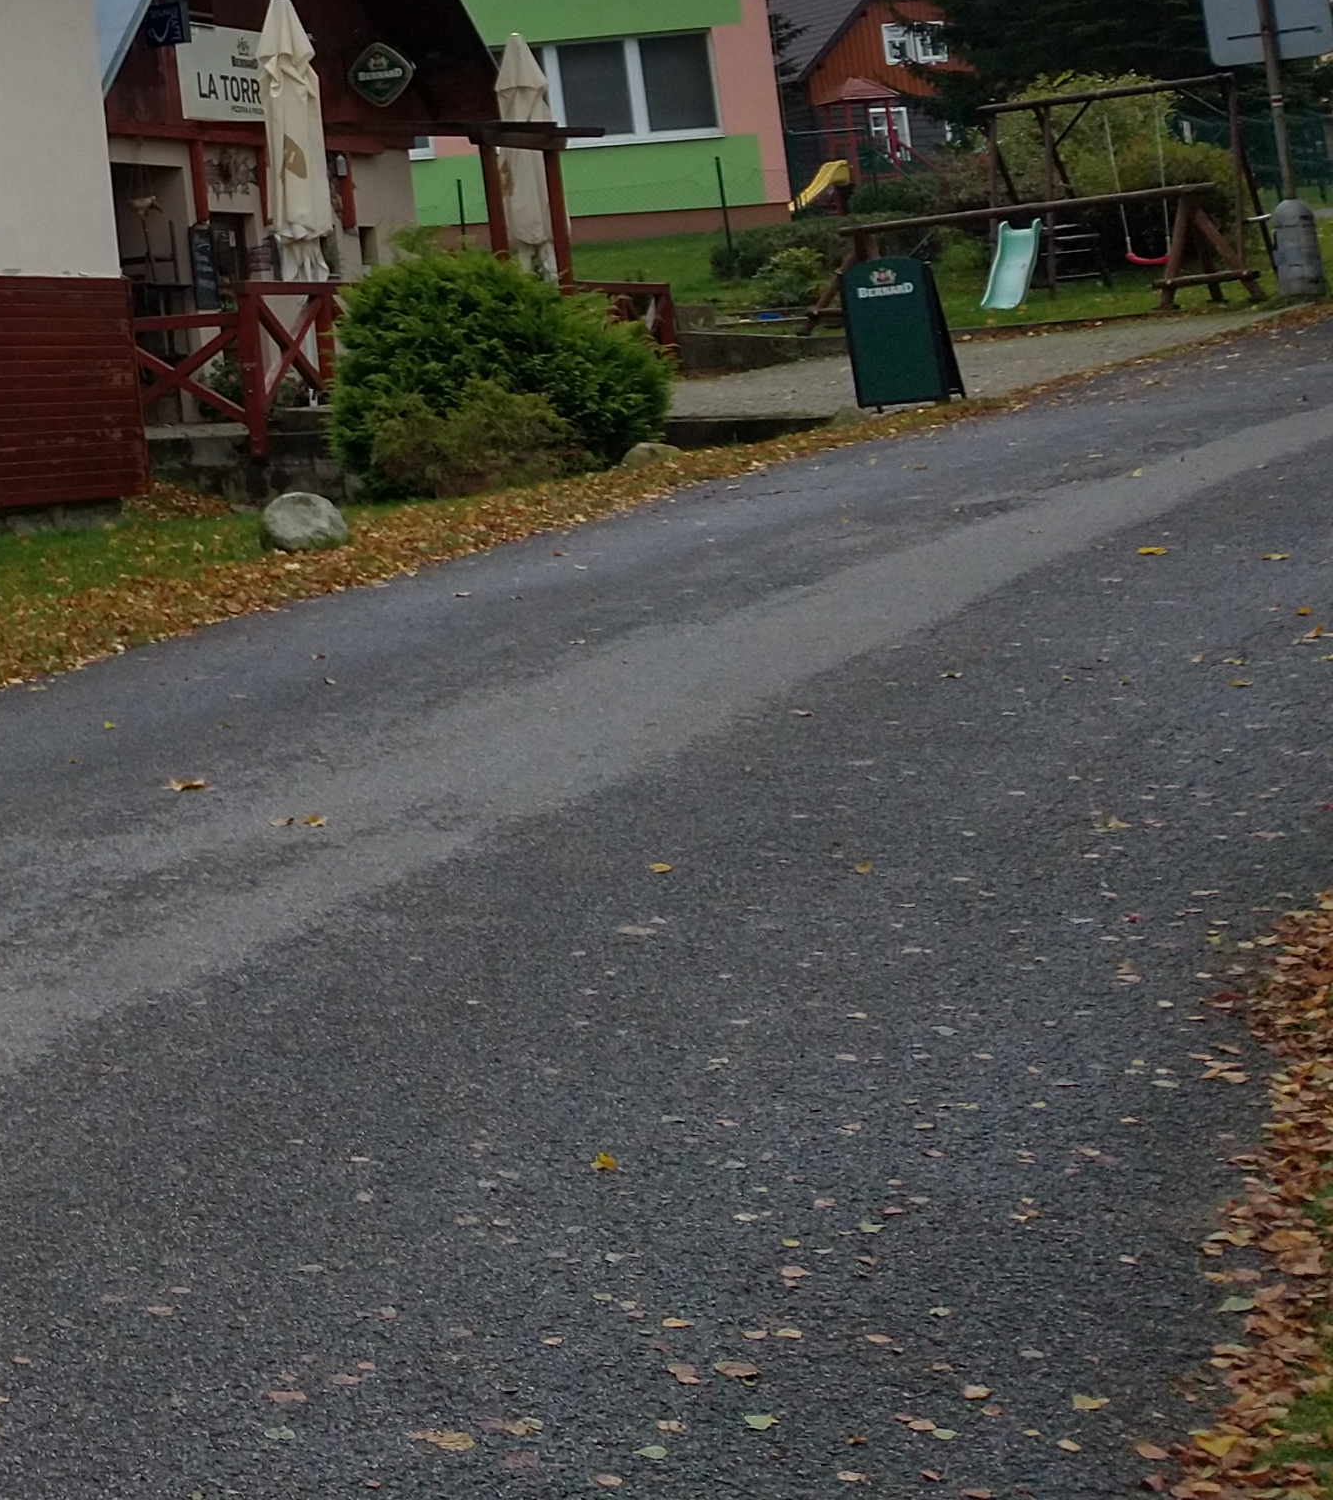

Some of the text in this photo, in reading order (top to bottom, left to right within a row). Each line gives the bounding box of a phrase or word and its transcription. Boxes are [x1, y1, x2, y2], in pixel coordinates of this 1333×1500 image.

[358, 67, 403, 81] BERNARD
[197, 71, 262, 105] LA TORR
[857, 282, 914, 299] BERNARD
